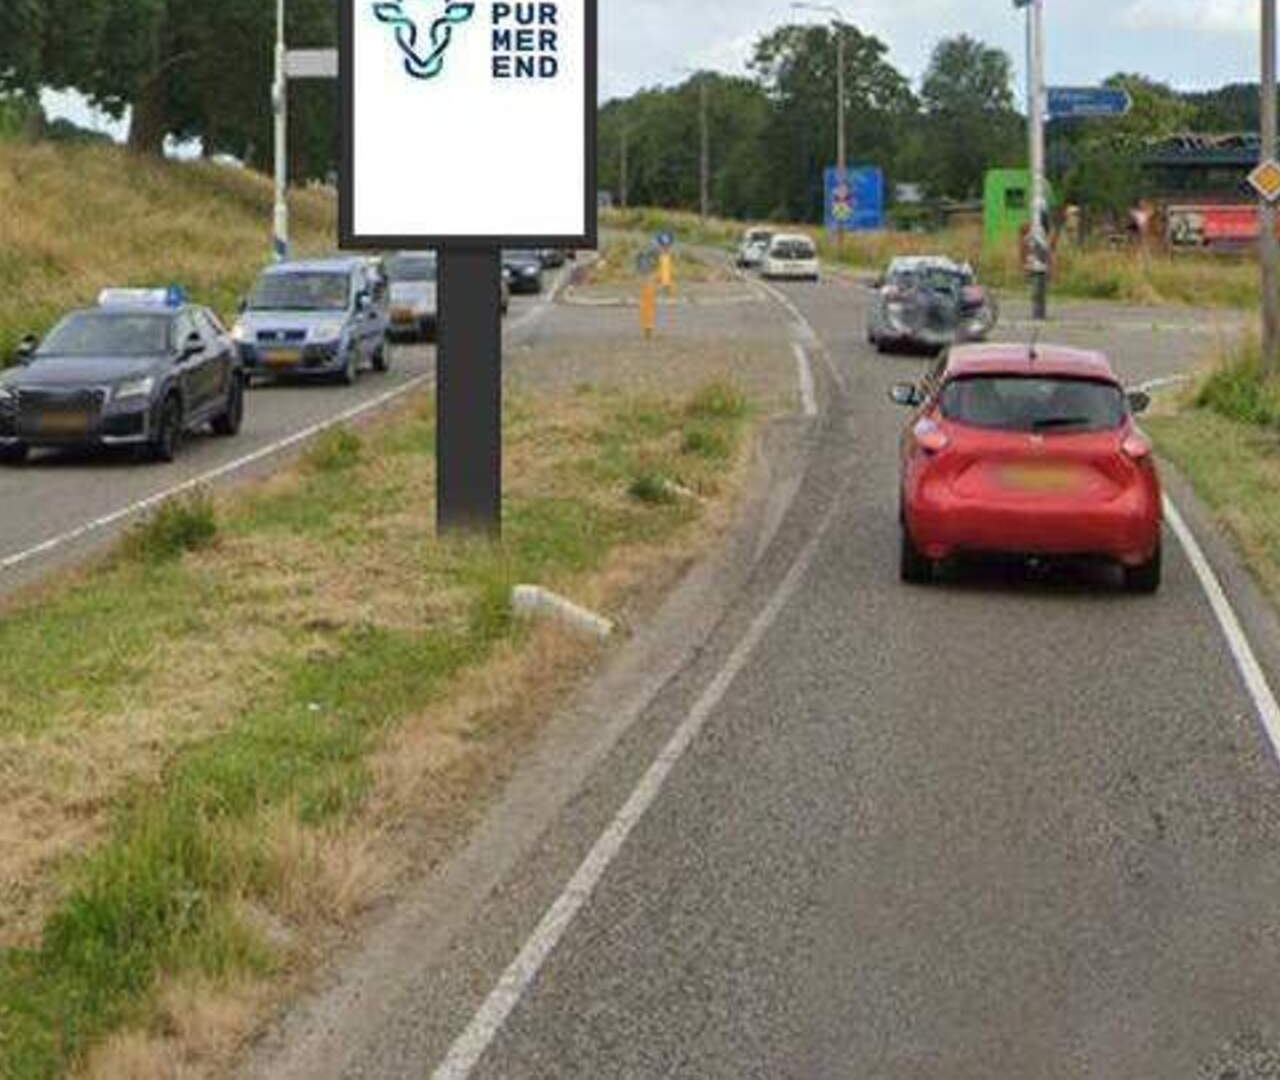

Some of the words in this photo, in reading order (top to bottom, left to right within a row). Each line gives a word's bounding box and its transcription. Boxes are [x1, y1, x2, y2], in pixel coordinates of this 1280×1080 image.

[492, 2, 557, 25] PUR
[492, 29, 557, 52] MER
[492, 55, 558, 78] END
